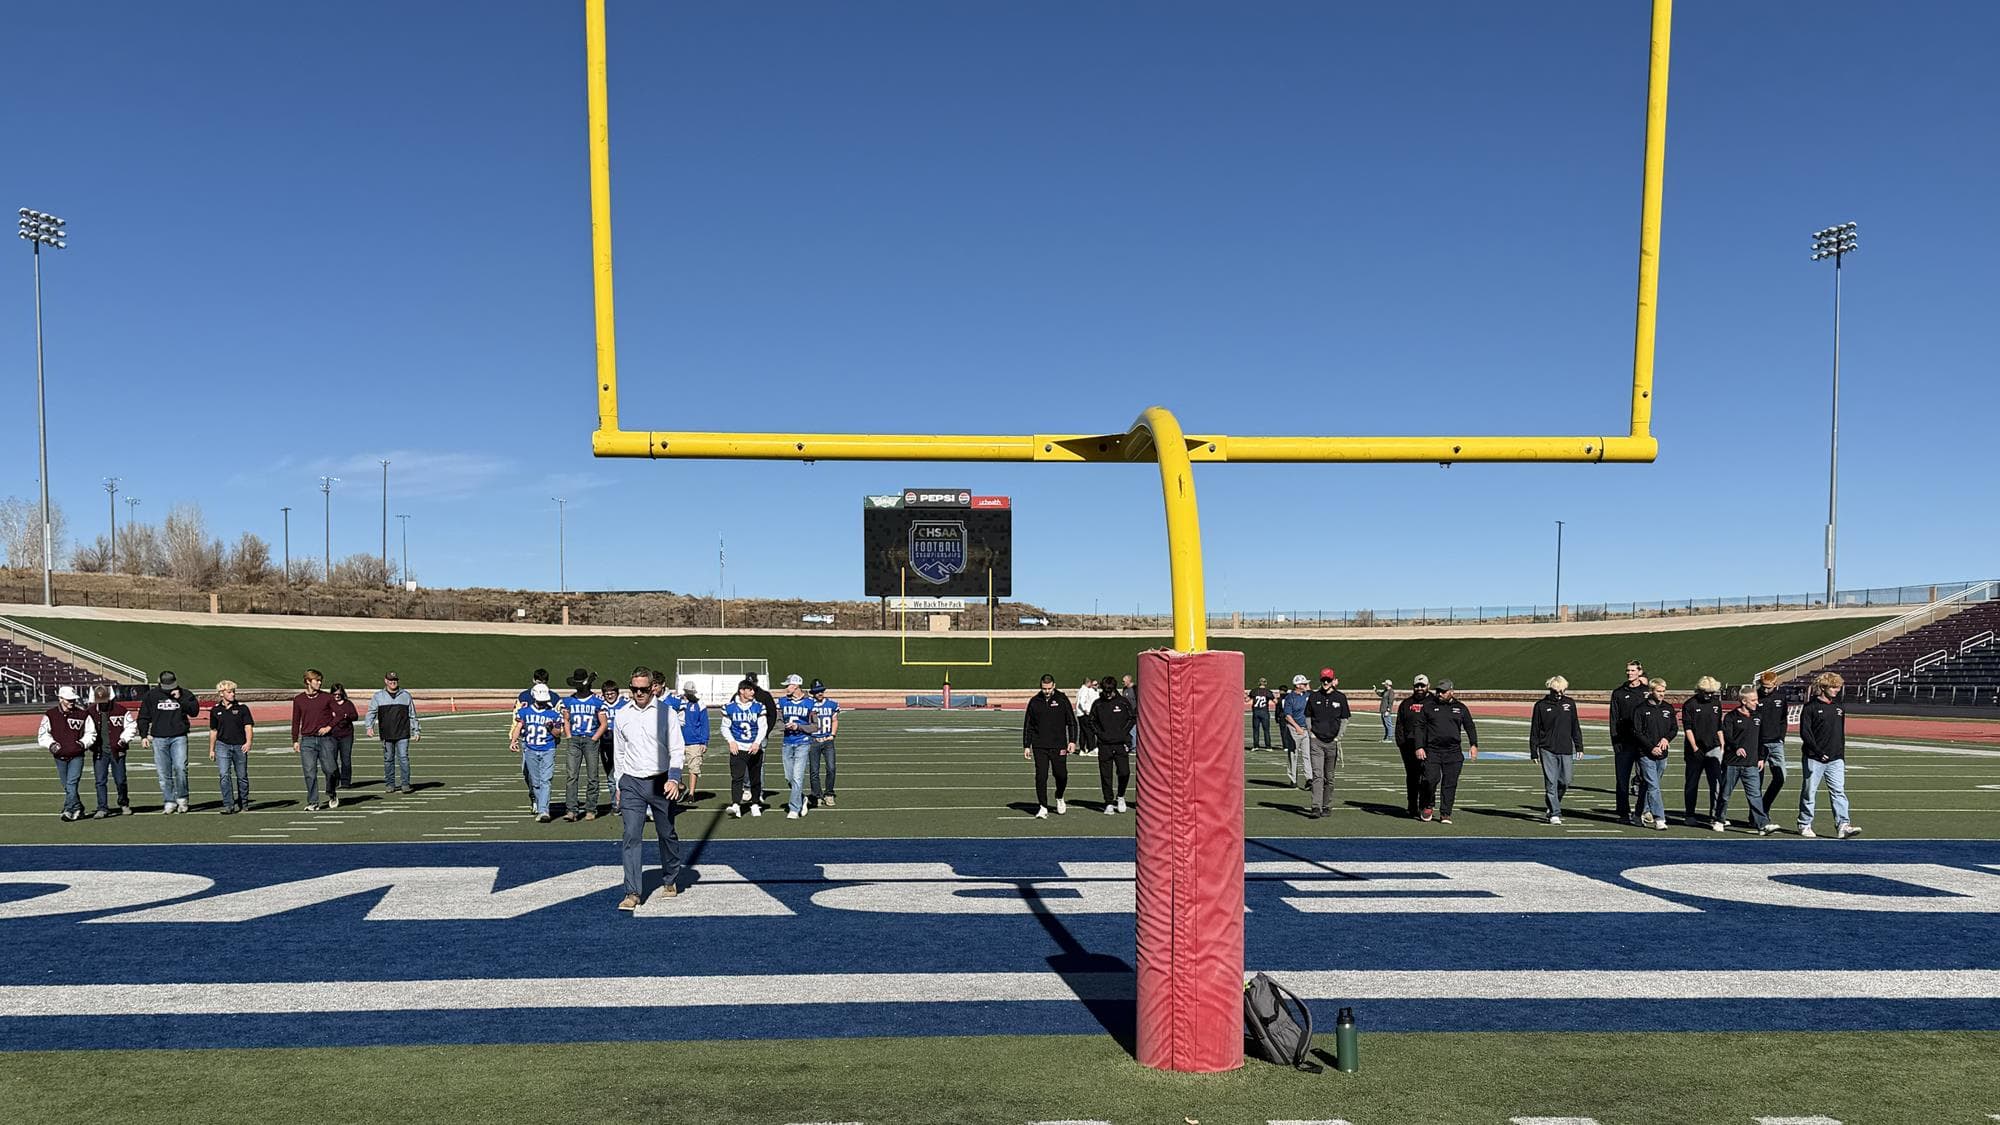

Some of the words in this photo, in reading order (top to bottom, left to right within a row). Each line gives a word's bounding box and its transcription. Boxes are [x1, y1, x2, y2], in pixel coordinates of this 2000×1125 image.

[920, 494, 955, 502] PEPSI
[918, 528, 958, 538] CHSAA
[915, 541, 961, 552] FOOTBALL
[1254, 696, 1267, 708] 72
[570, 704, 596, 714] AKRON
[783, 706, 808, 717] AKRON
[732, 712, 758, 722] AKRON
[572, 715, 594, 733] 27
[526, 724, 547, 745] 22
[740, 722, 752, 741] 3
